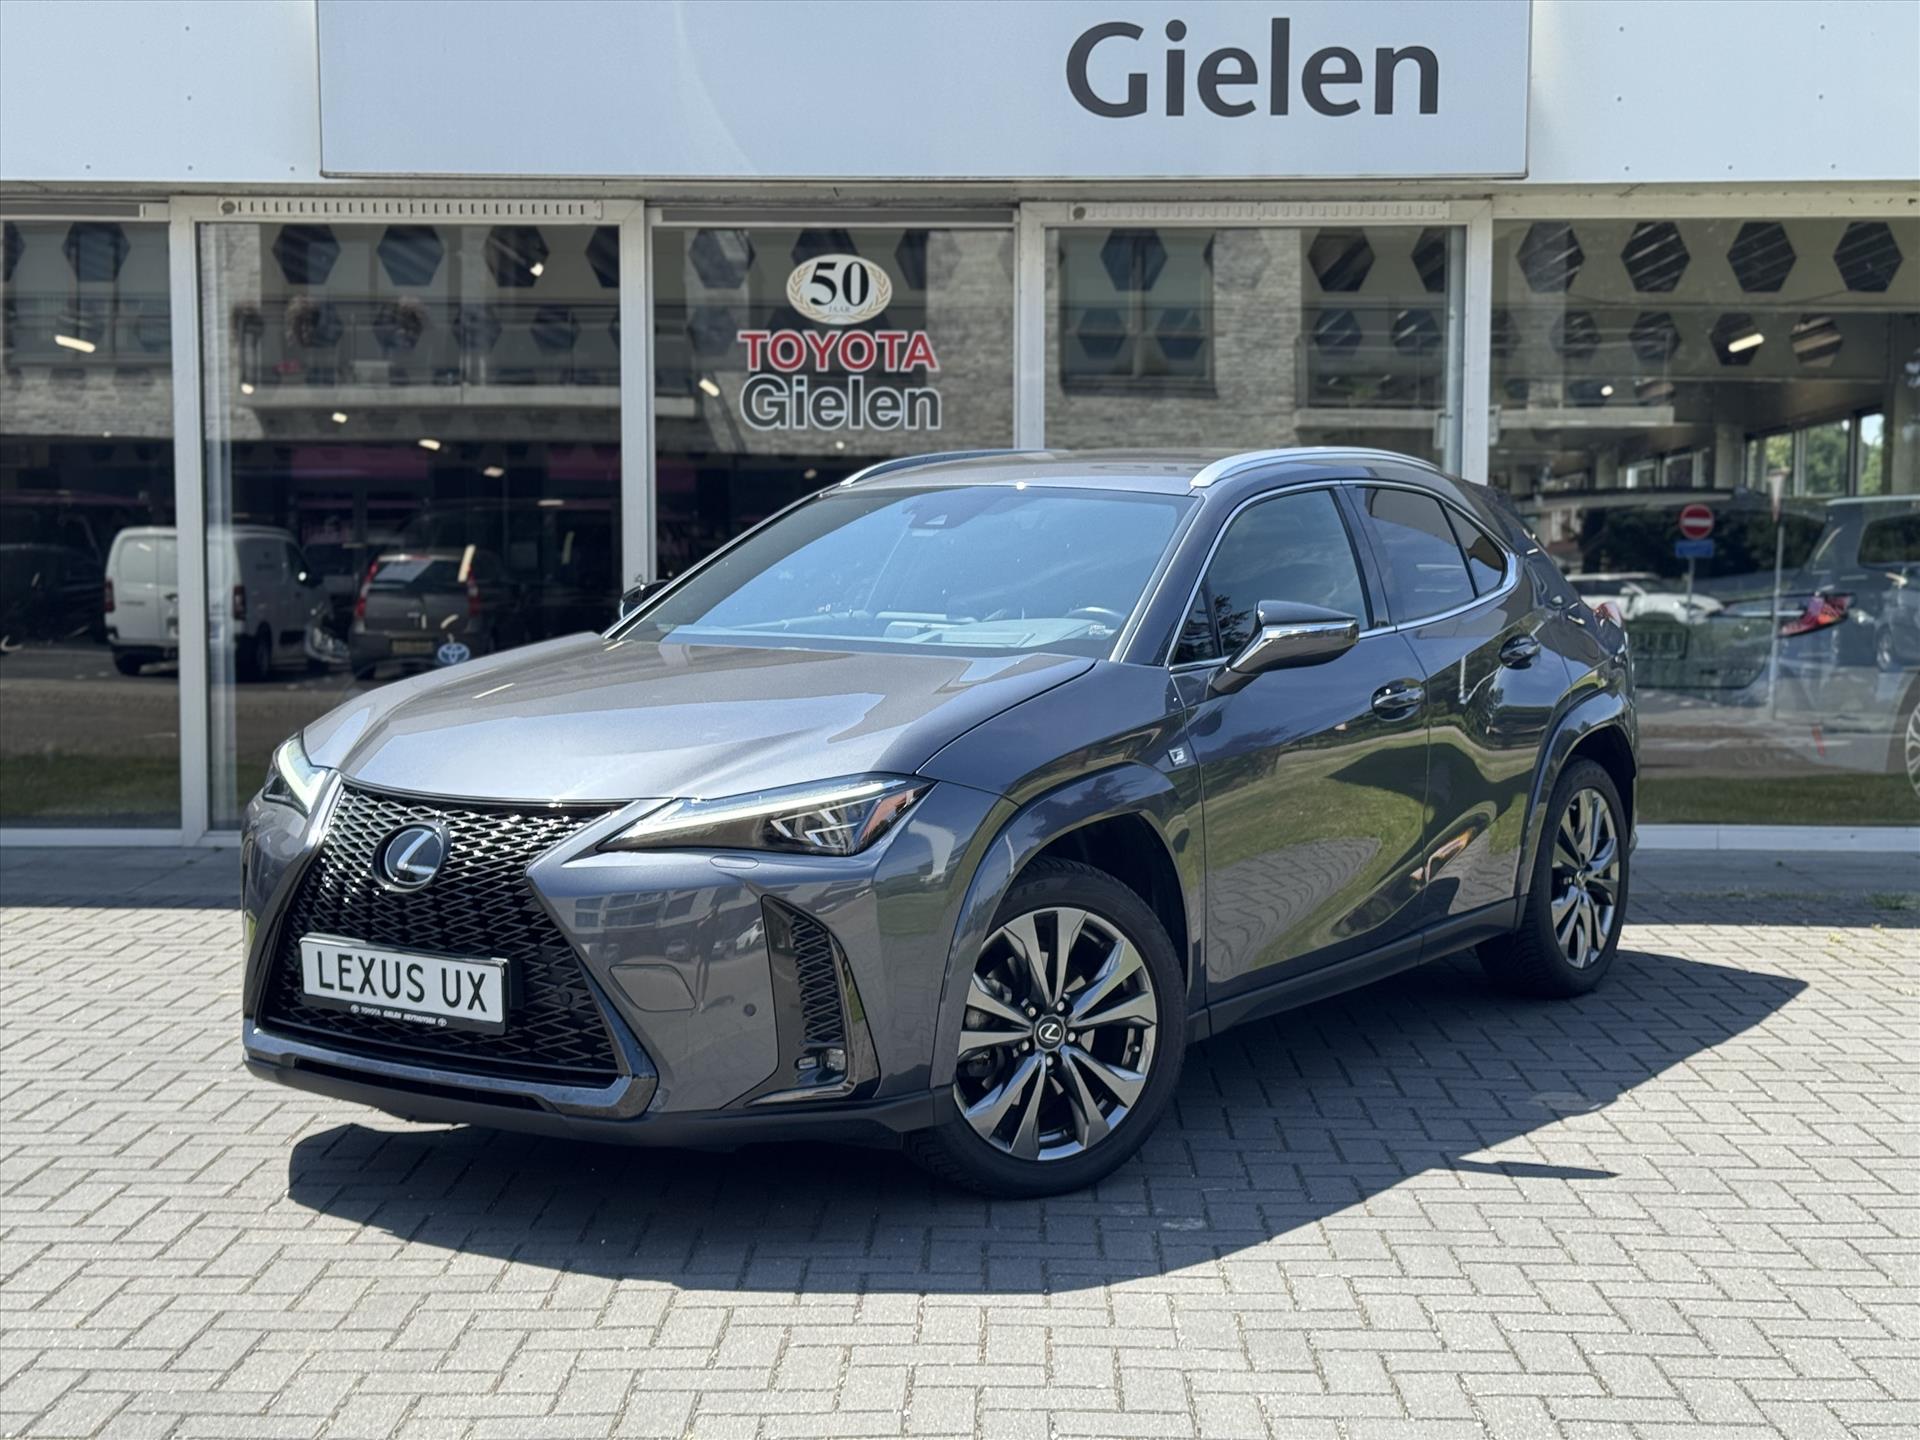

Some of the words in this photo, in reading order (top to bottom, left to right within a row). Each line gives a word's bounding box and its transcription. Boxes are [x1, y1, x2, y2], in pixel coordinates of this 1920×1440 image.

[1066, 17, 1439, 119] Gielen
[810, 261, 870, 307] 50
[738, 330, 940, 372] TOYOTA
[740, 374, 942, 430] Gielen
[317, 951, 425, 1003] LEXUS
[441, 968, 488, 1012] UX
